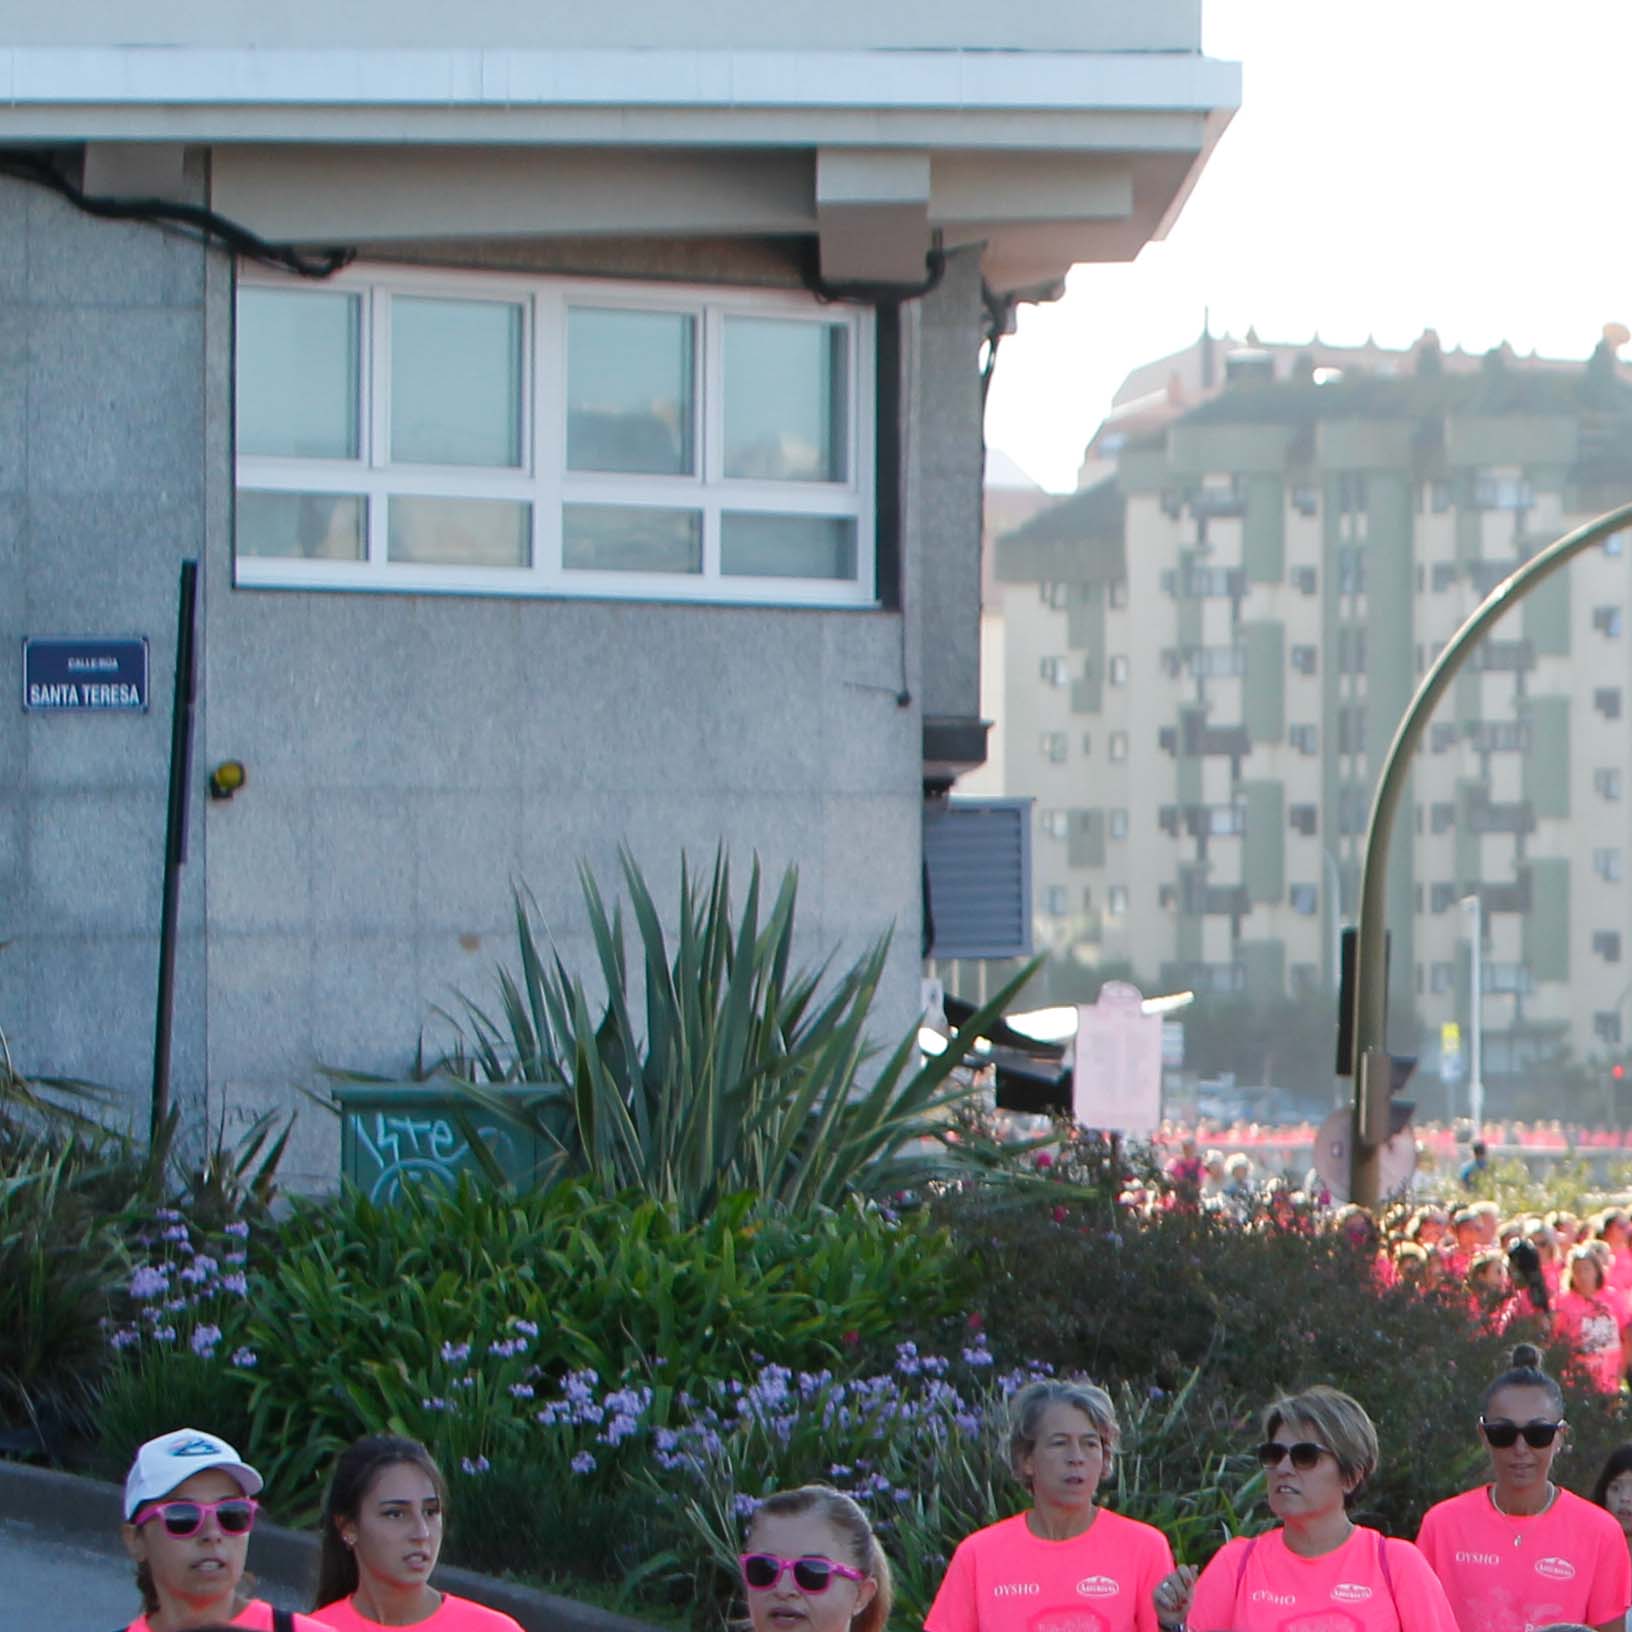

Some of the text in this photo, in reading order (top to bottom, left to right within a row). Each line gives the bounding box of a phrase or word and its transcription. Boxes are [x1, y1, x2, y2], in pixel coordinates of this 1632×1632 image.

[31, 683, 140, 705] SANTA TERESA
[1456, 1552, 1500, 1565] OYSHO
[994, 1583, 1039, 1598] OYSHO
